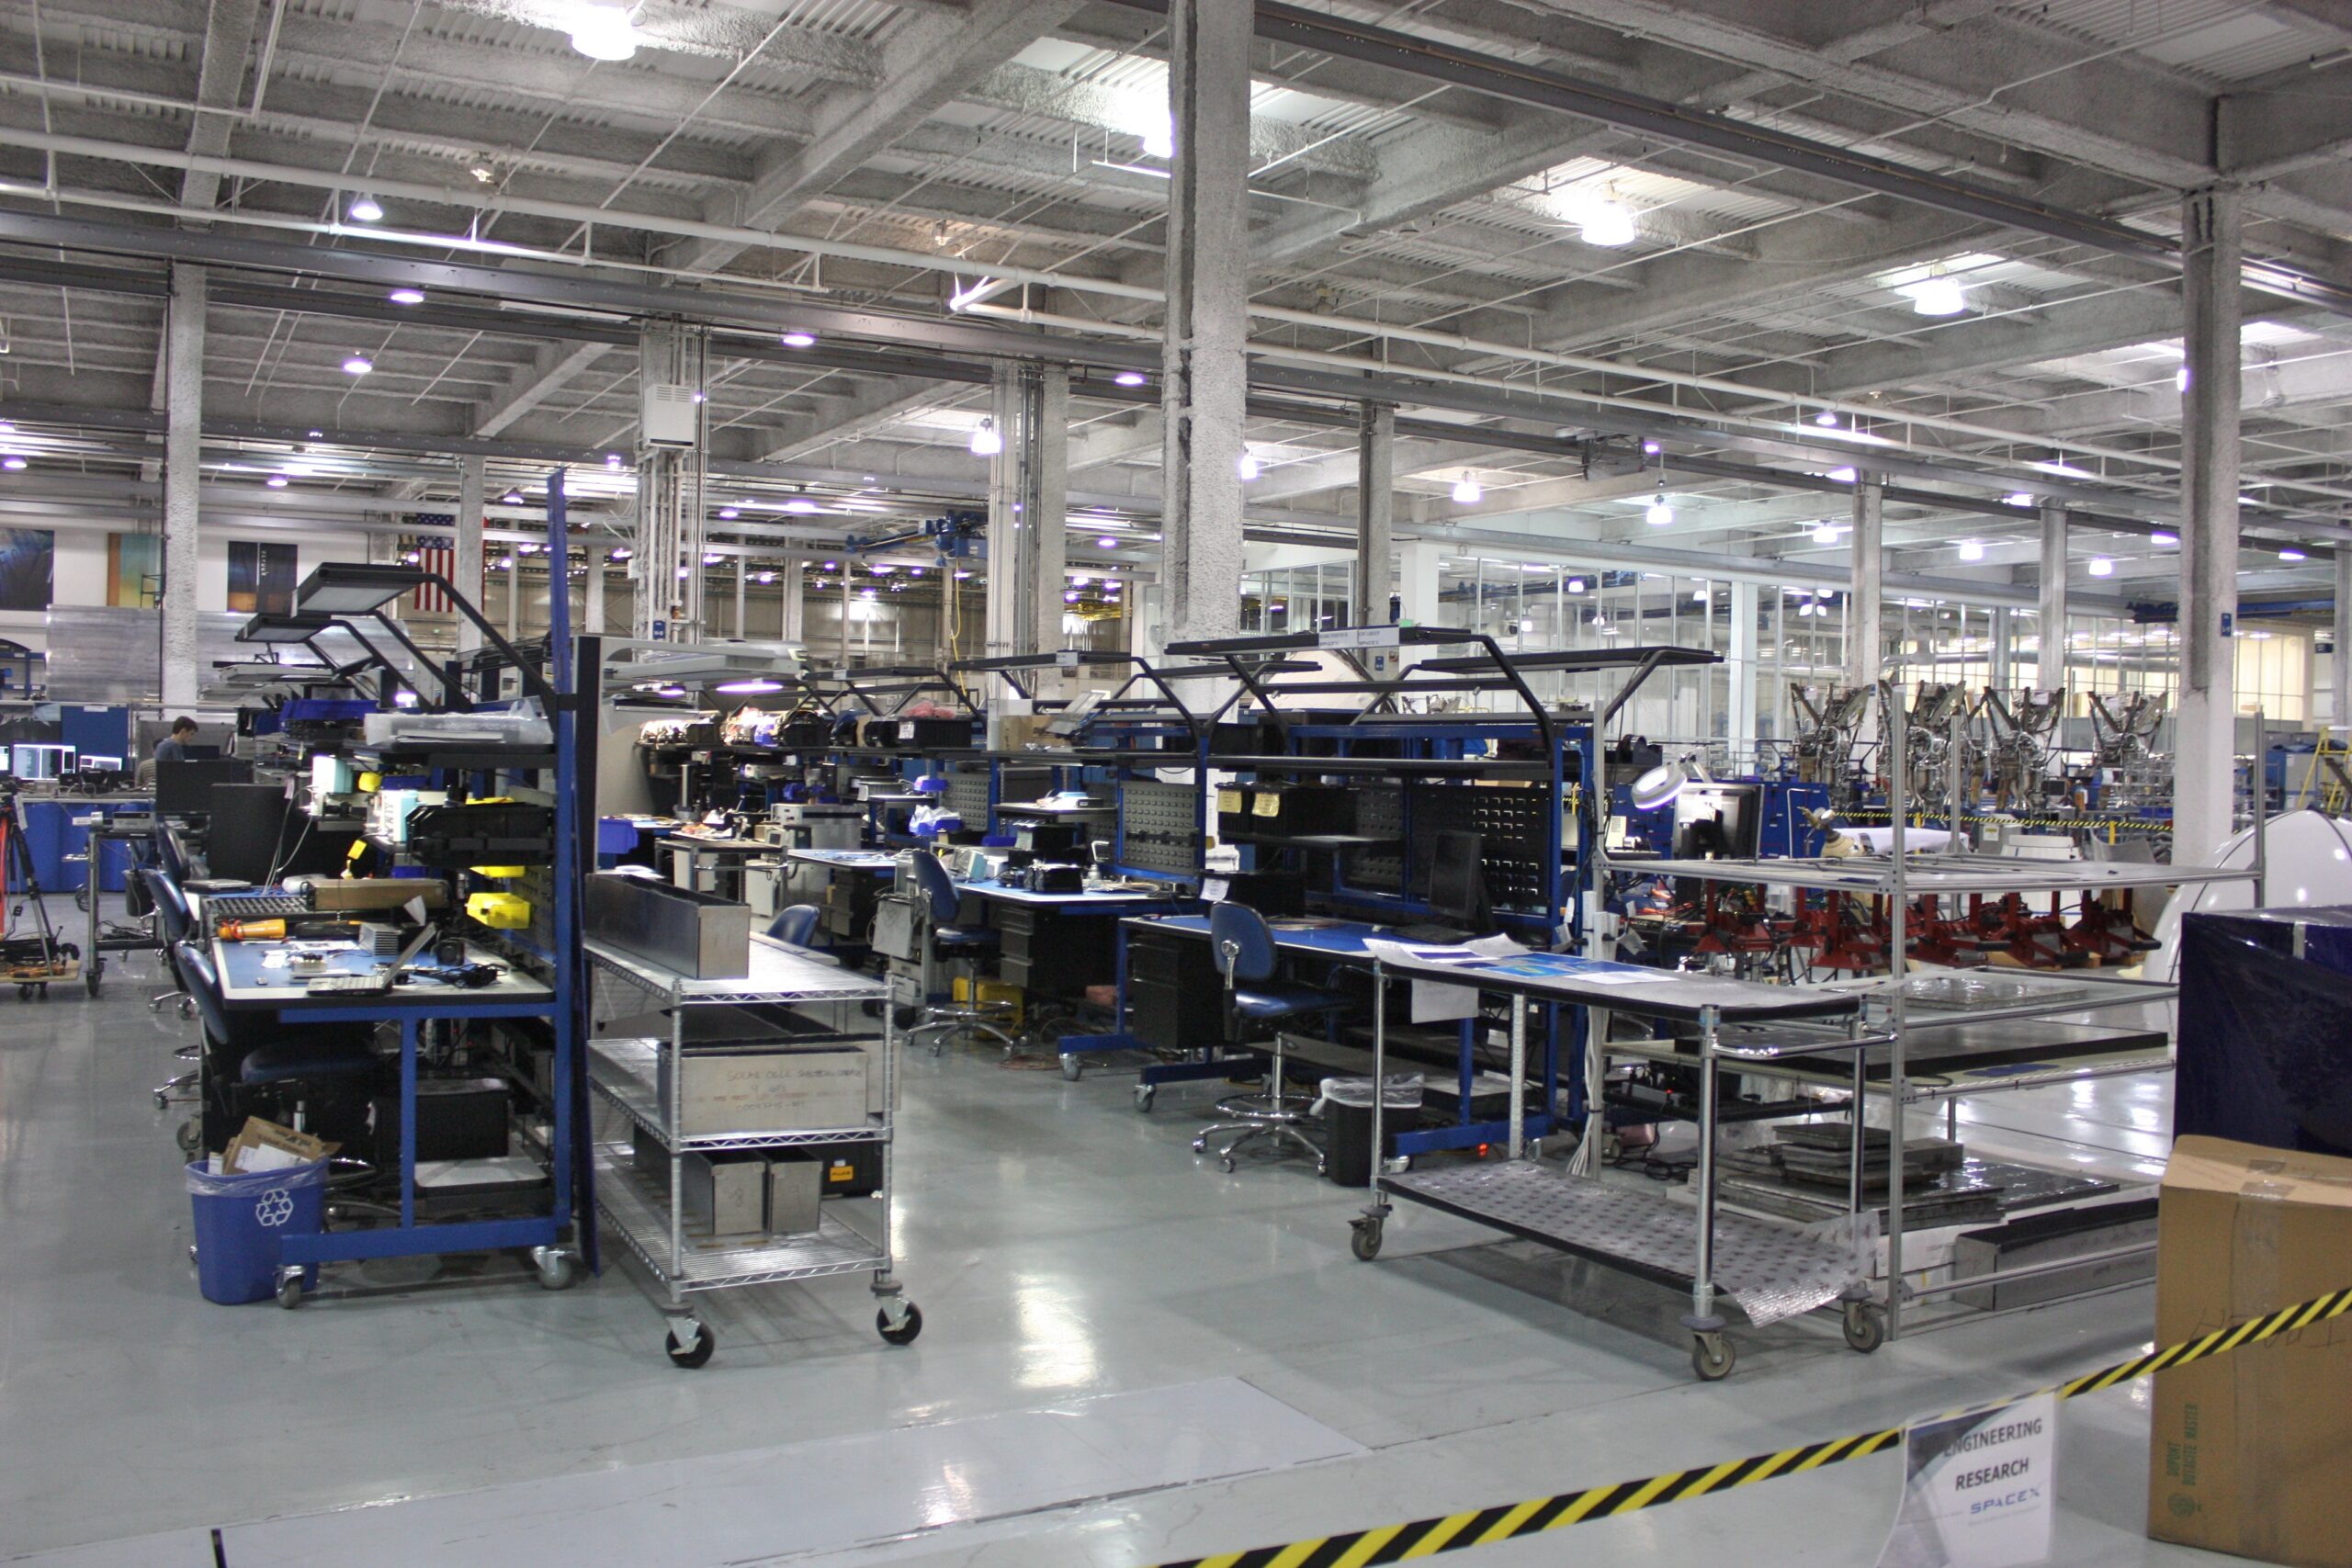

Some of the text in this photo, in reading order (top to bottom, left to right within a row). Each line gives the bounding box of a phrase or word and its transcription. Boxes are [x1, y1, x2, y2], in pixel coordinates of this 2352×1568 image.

[1942, 1418, 2042, 1458] ENGINEERING
[2184, 1402, 2199, 1439] MASTER
[1955, 1457, 2030, 1492] RESEARCH
[1970, 1485, 2042, 1515] SPACEX
